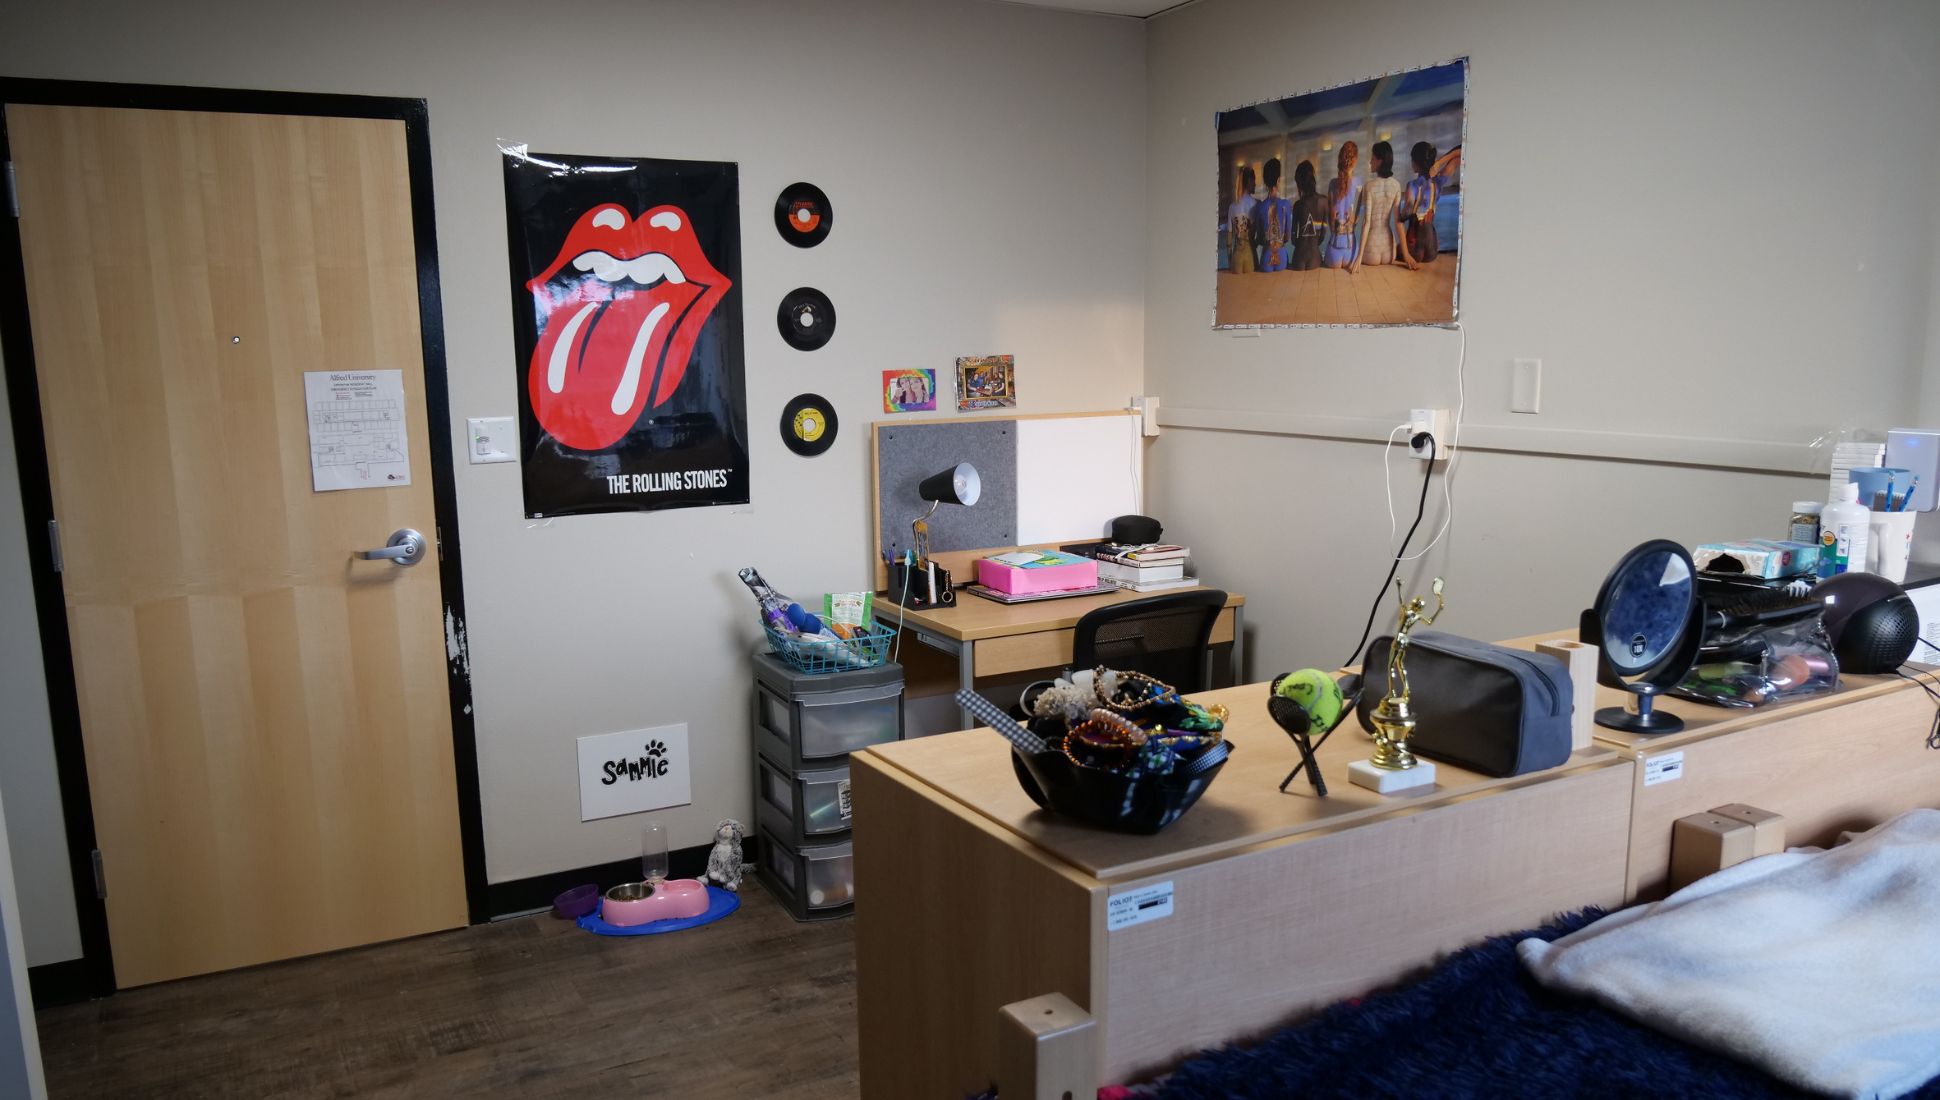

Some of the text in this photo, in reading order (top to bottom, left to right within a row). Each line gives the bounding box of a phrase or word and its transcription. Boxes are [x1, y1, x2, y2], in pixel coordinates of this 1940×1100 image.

[606, 474, 630, 494] THE
[632, 471, 682, 493] ROLLING
[1109, 895, 1133, 907] FOLIOT
